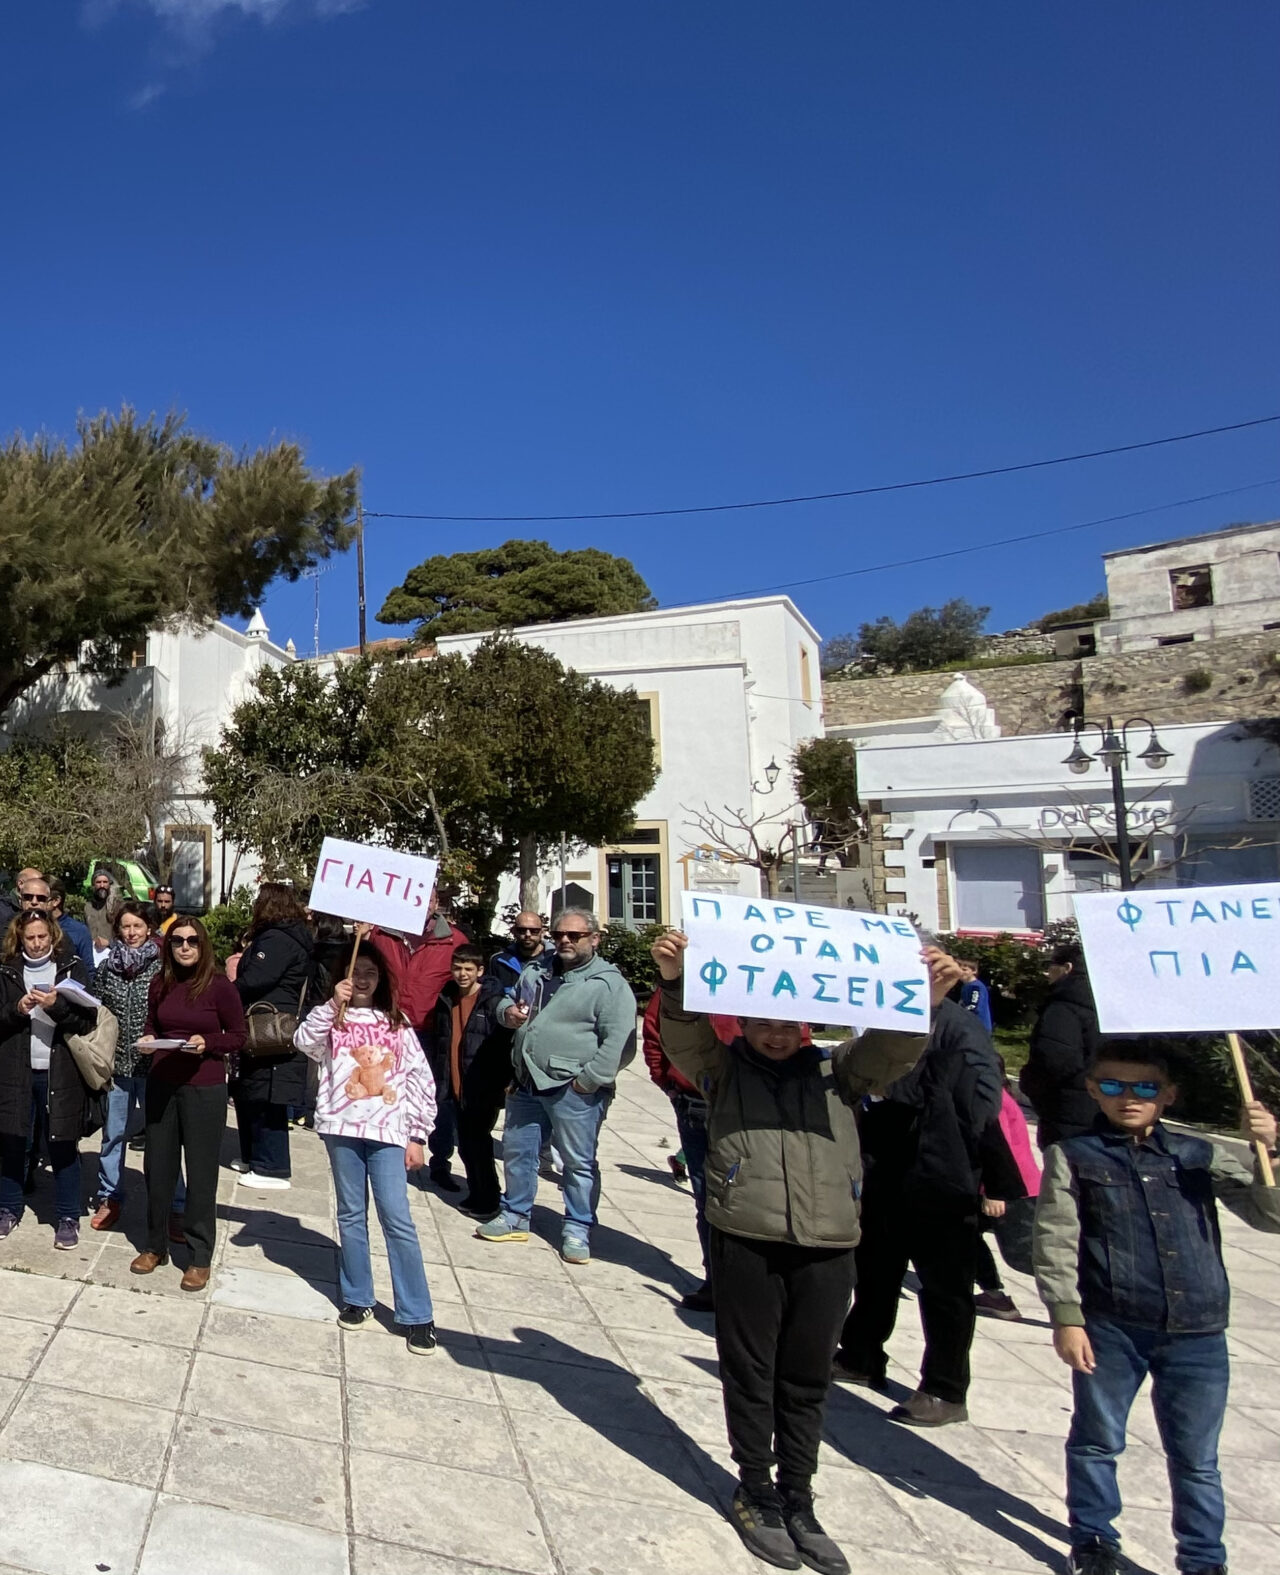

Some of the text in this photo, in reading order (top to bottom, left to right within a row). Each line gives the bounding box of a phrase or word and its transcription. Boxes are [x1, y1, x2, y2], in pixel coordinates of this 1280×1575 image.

[321, 858, 424, 907] ΓΙΑΤΙ;
[693, 898, 916, 938] ΠΑΡΕ ΜΕ
[1117, 897, 1280, 932] ΦΤΑΝΕ
[750, 933, 880, 965] ΟΤΑΝ
[1149, 950, 1258, 978] ΠΙΑ
[699, 956, 925, 1016] ΦΤΑΣΕΙΣ
